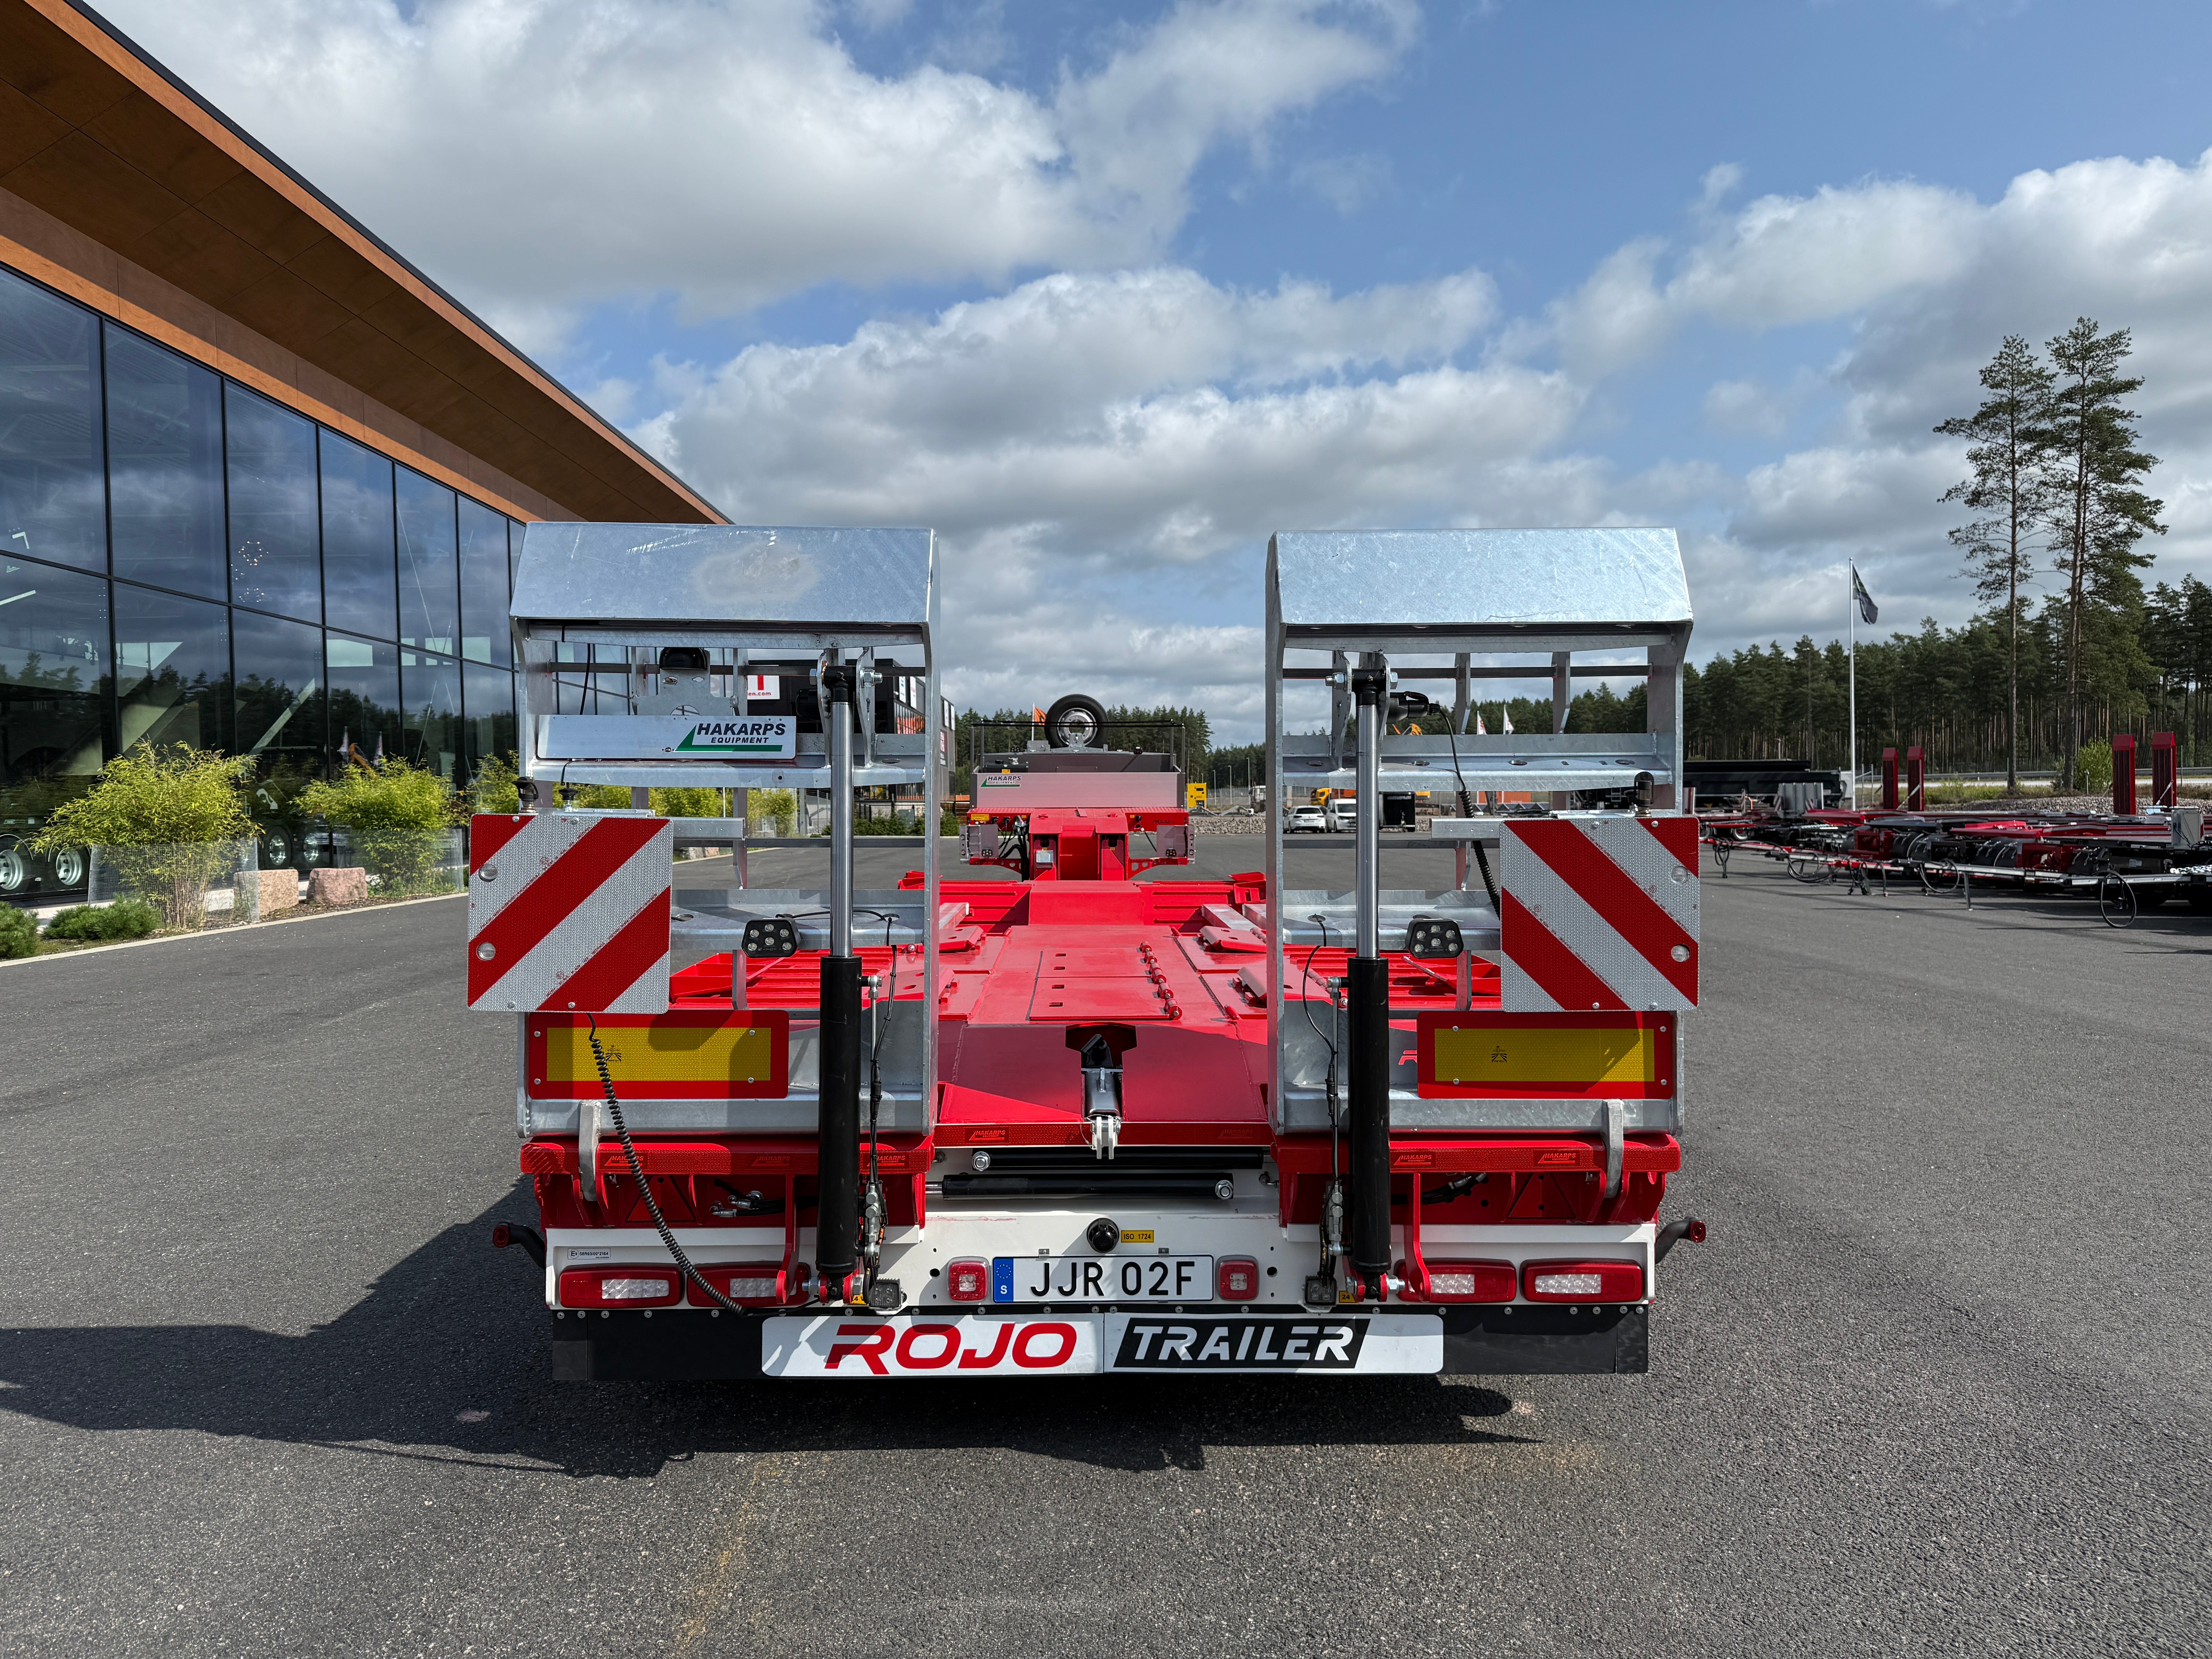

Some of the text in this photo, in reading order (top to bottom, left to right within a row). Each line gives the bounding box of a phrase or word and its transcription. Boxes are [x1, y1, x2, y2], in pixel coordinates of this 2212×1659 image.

[697, 723, 786, 735] HAKARPS
[1000, 1285, 1007, 1295] S
[1030, 1261, 1195, 1297] JJR 02F
[824, 1322, 1354, 1374] ROJO TRAILER
